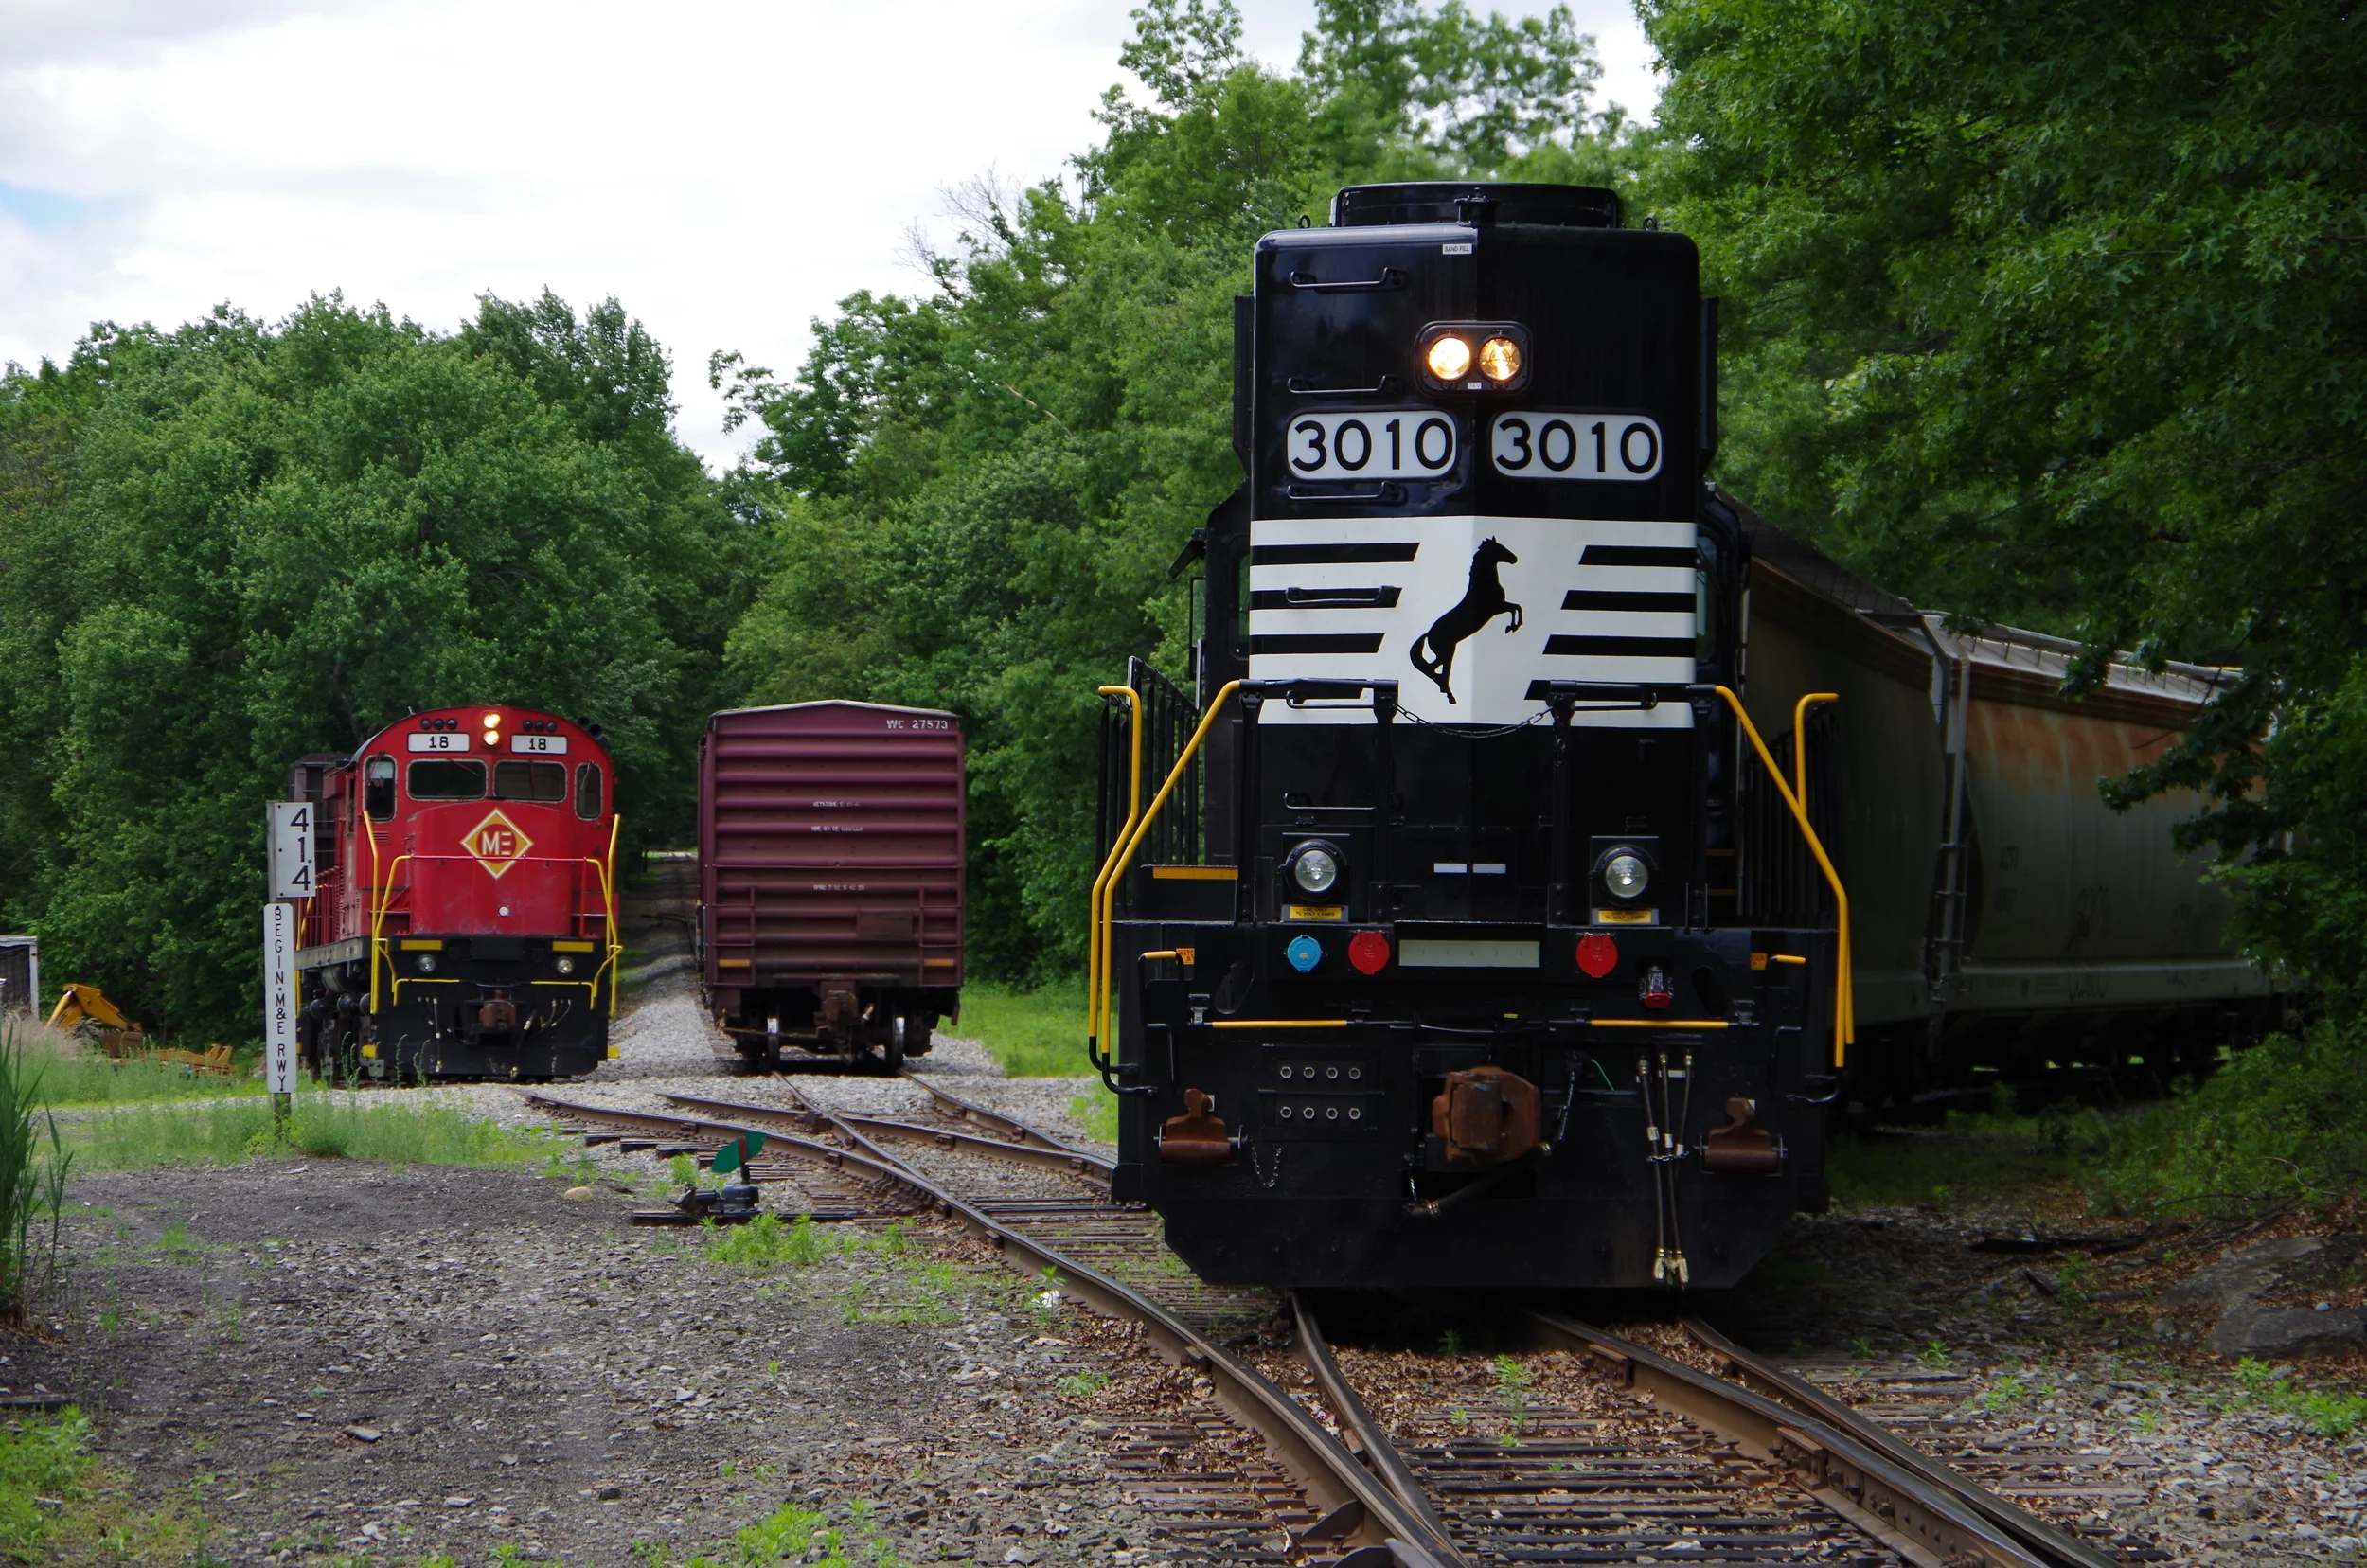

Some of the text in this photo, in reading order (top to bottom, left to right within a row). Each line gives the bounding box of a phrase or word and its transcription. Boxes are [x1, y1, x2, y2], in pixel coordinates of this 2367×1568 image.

[1291, 418, 1454, 472] 3010
[1495, 418, 1659, 474] 3010
[886, 719, 949, 730] WC 27573
[429, 736, 449, 749] 18
[528, 738, 547, 751] 18
[276, 1043, 287, 1087] RWY
